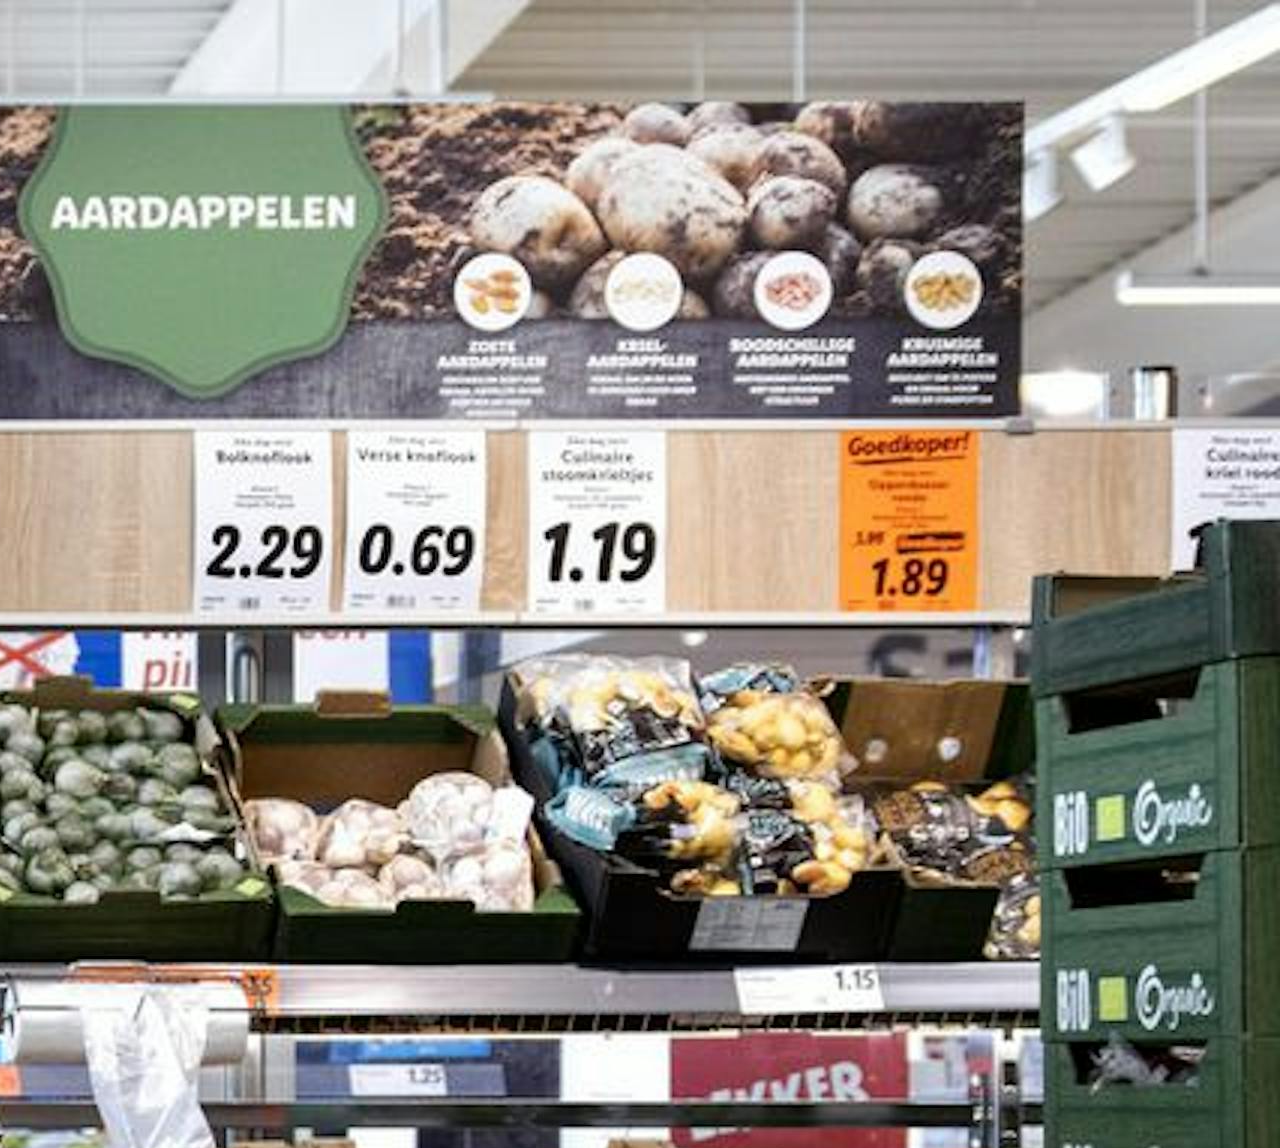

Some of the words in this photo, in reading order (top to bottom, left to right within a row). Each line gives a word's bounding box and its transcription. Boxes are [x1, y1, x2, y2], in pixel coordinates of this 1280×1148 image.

[50, 195, 356, 230] AARDAPPELEN
[436, 355, 549, 370] AARDAPPELEN
[585, 354, 698, 369] AARDAPPELEN
[735, 353, 848, 368] AARDAPPELEN
[886, 352, 999, 368] AARDAPPELEN
[357, 447, 402, 463] Verse
[406, 448, 477, 464] knoflook
[848, 432, 970, 456] Goedkoper!
[216, 449, 313, 464] Bolknoflook
[560, 450, 635, 464] Culinaire
[542, 468, 654, 485] stoomkrieltjes
[206, 524, 323, 579] 2.29
[359, 523, 475, 577] 0.69
[544, 522, 656, 583] 1.19
[872, 558, 949, 597] 1.89
[1133, 780, 1213, 845] Organic
[834, 968, 877, 991] 1.15
[1135, 964, 1214, 1030] Organic
